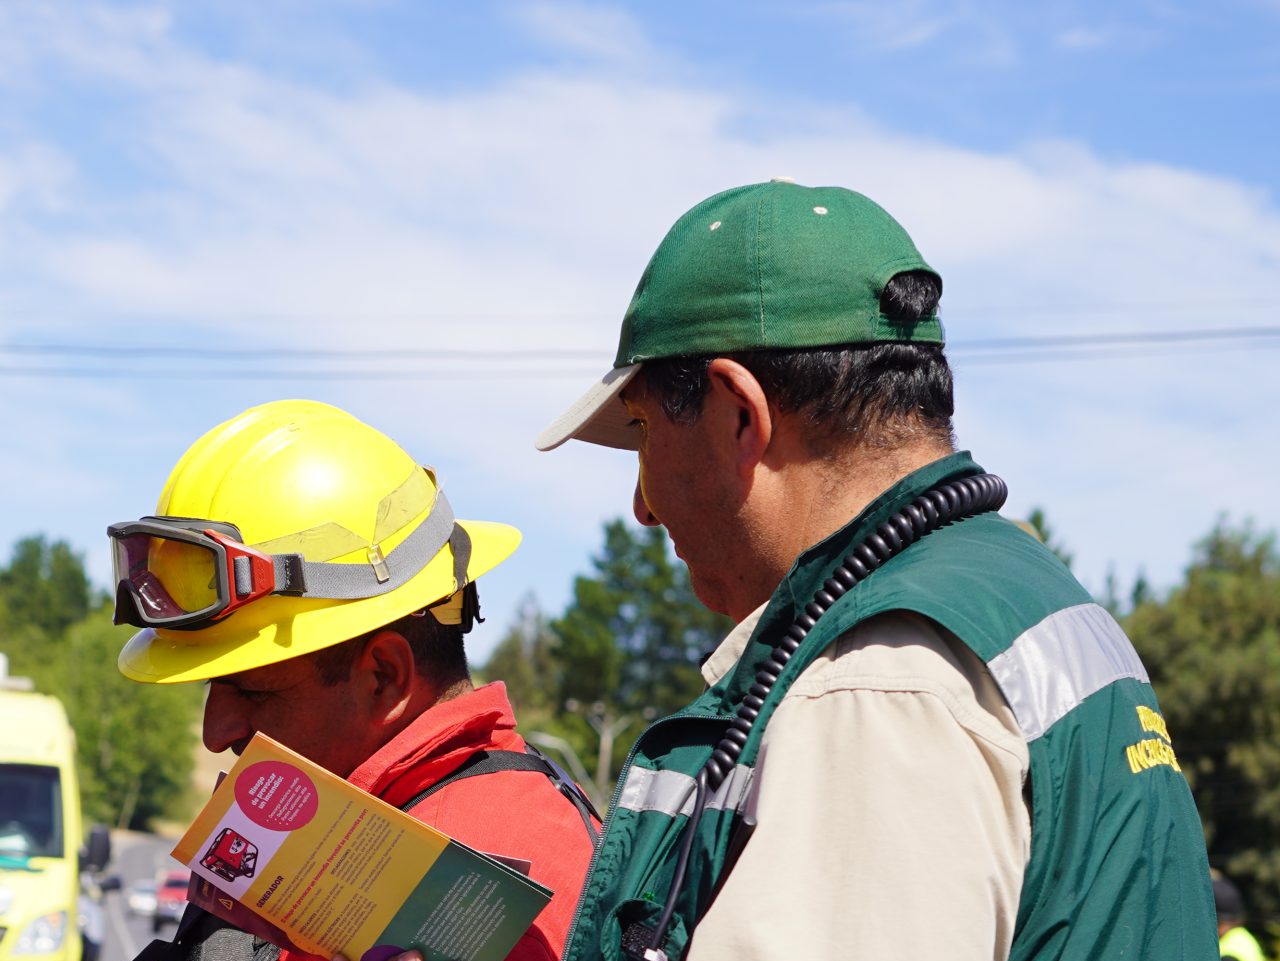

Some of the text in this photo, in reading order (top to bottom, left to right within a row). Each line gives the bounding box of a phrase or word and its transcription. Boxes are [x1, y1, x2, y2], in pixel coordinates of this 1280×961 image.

[248, 776, 264, 795] Riesgo
[257, 773, 276, 798] provocar
[258, 776, 284, 809] un incendio:
[295, 886, 312, 905] provocar
[313, 861, 329, 881] incendio
[326, 843, 342, 862] forestal
[343, 818, 361, 840] presenta
[256, 875, 284, 908] GENERADOR
